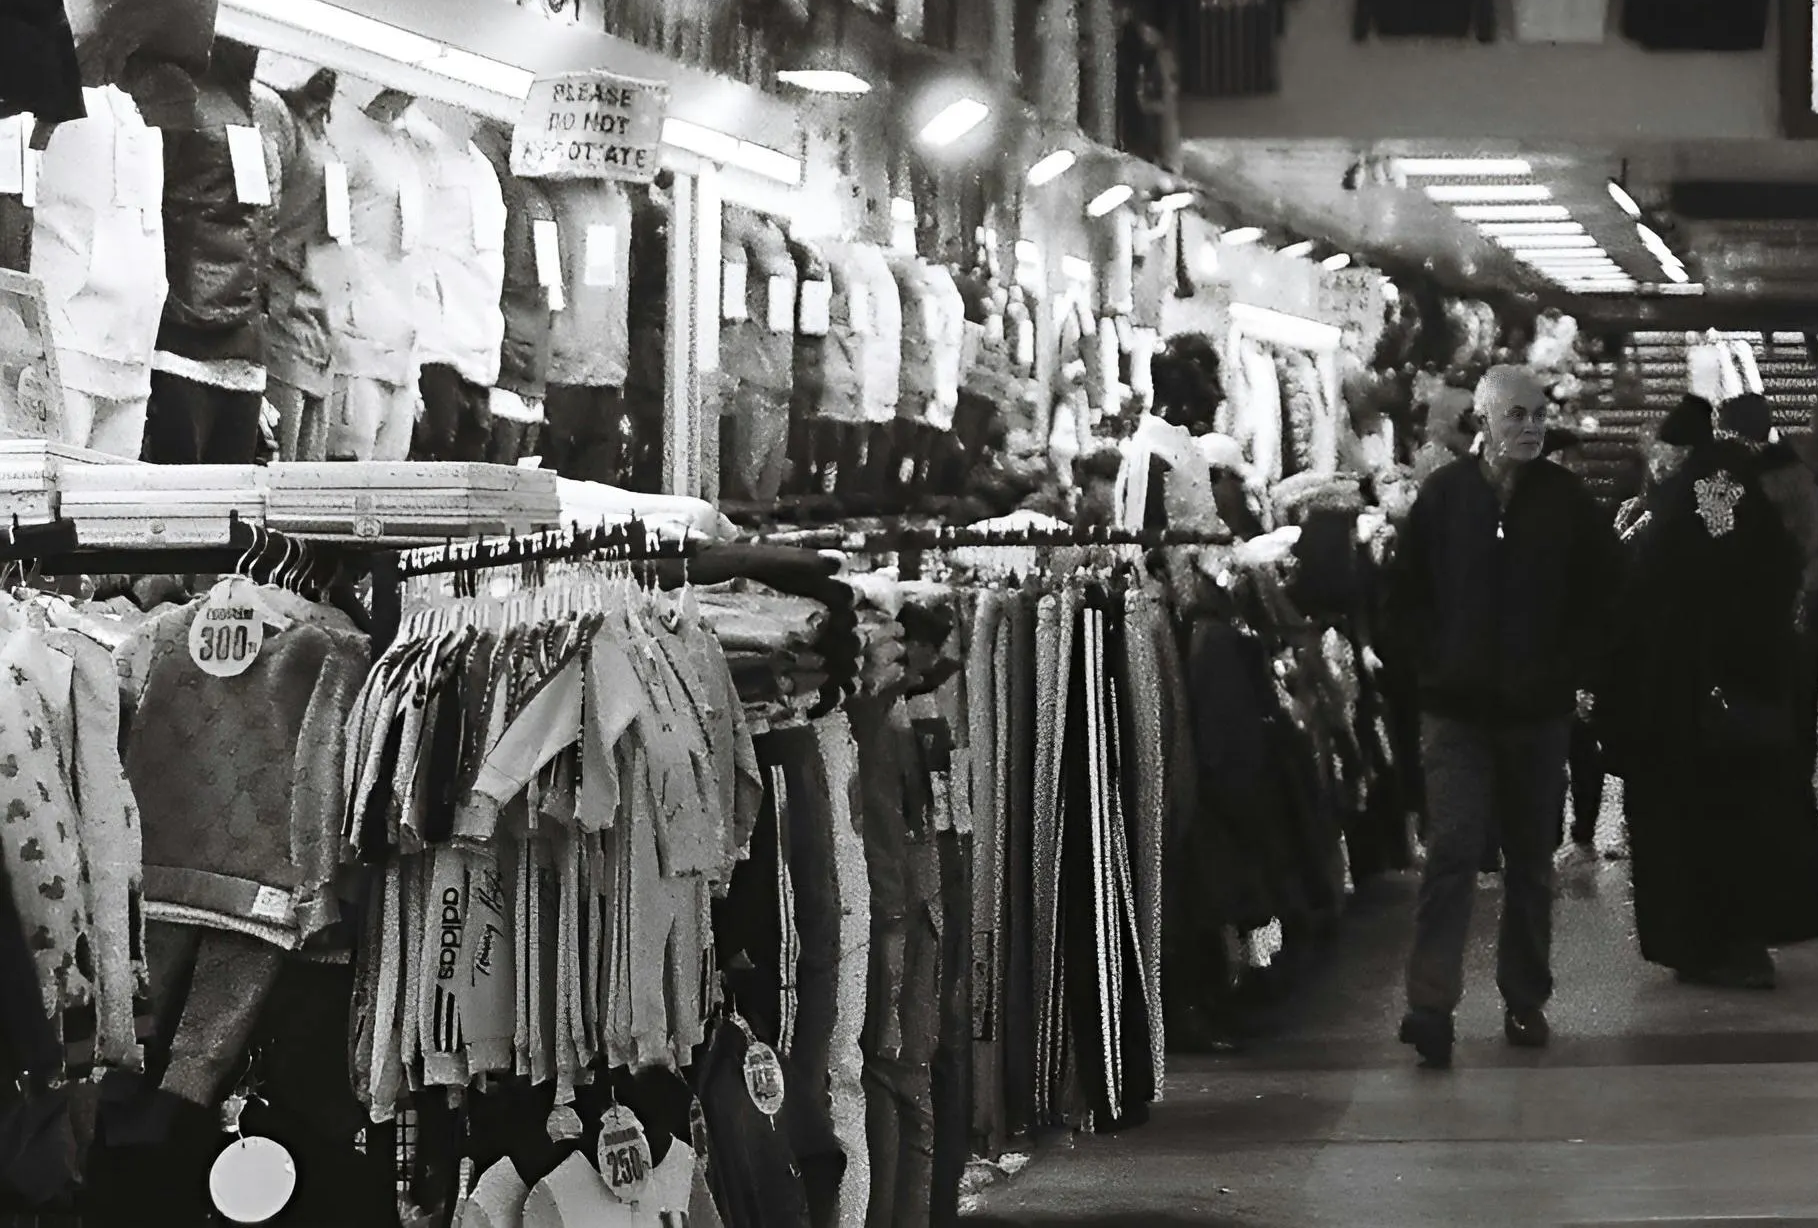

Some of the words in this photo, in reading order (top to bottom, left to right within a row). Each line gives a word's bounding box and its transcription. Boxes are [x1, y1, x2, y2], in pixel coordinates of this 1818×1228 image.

[553, 82, 636, 108] PLEASE
[584, 112, 631, 135] NOT
[199, 624, 248, 662] 300
[437, 887, 463, 980] adidas
